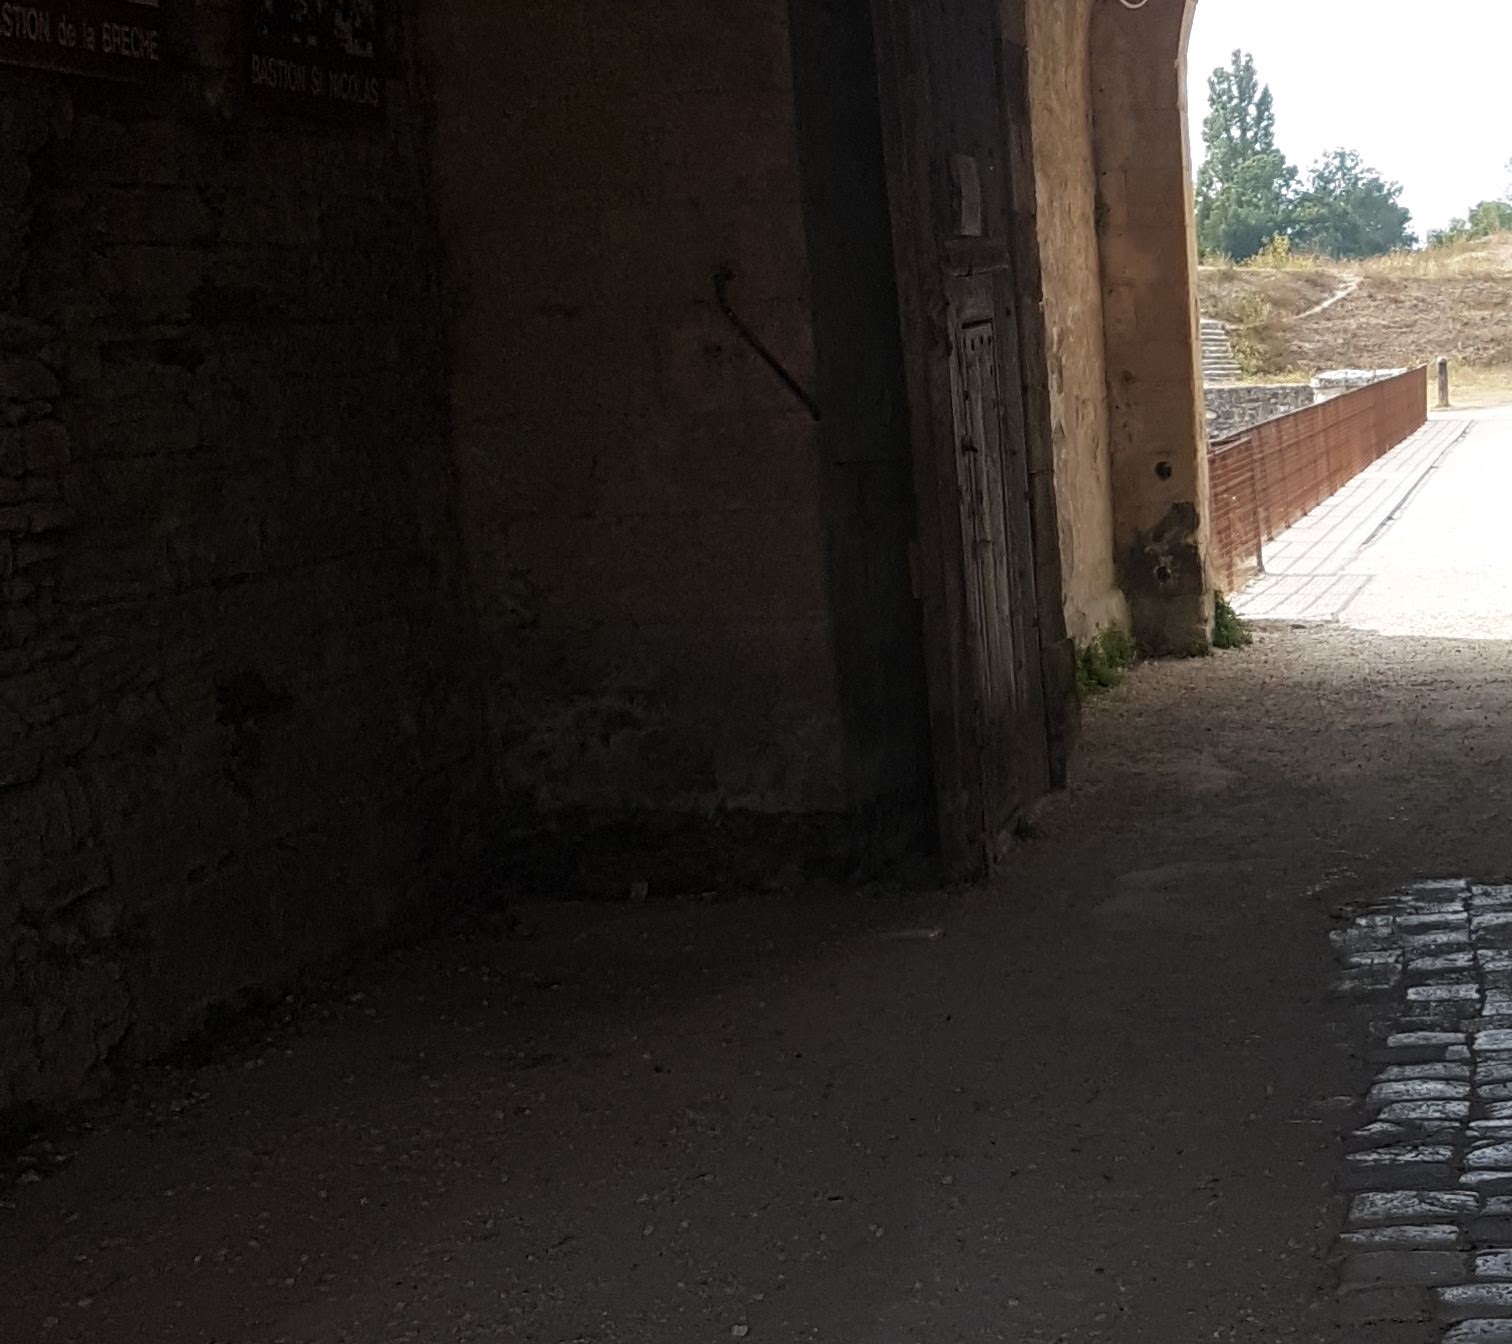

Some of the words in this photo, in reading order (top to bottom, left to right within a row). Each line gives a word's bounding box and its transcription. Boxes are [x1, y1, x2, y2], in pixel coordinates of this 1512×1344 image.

[0, 1, 51, 43] STION
[57, 14, 76, 47] de
[82, 16, 96, 52] la
[251, 53, 307, 92] BASTION
[328, 69, 380, 109] NICOLAS
